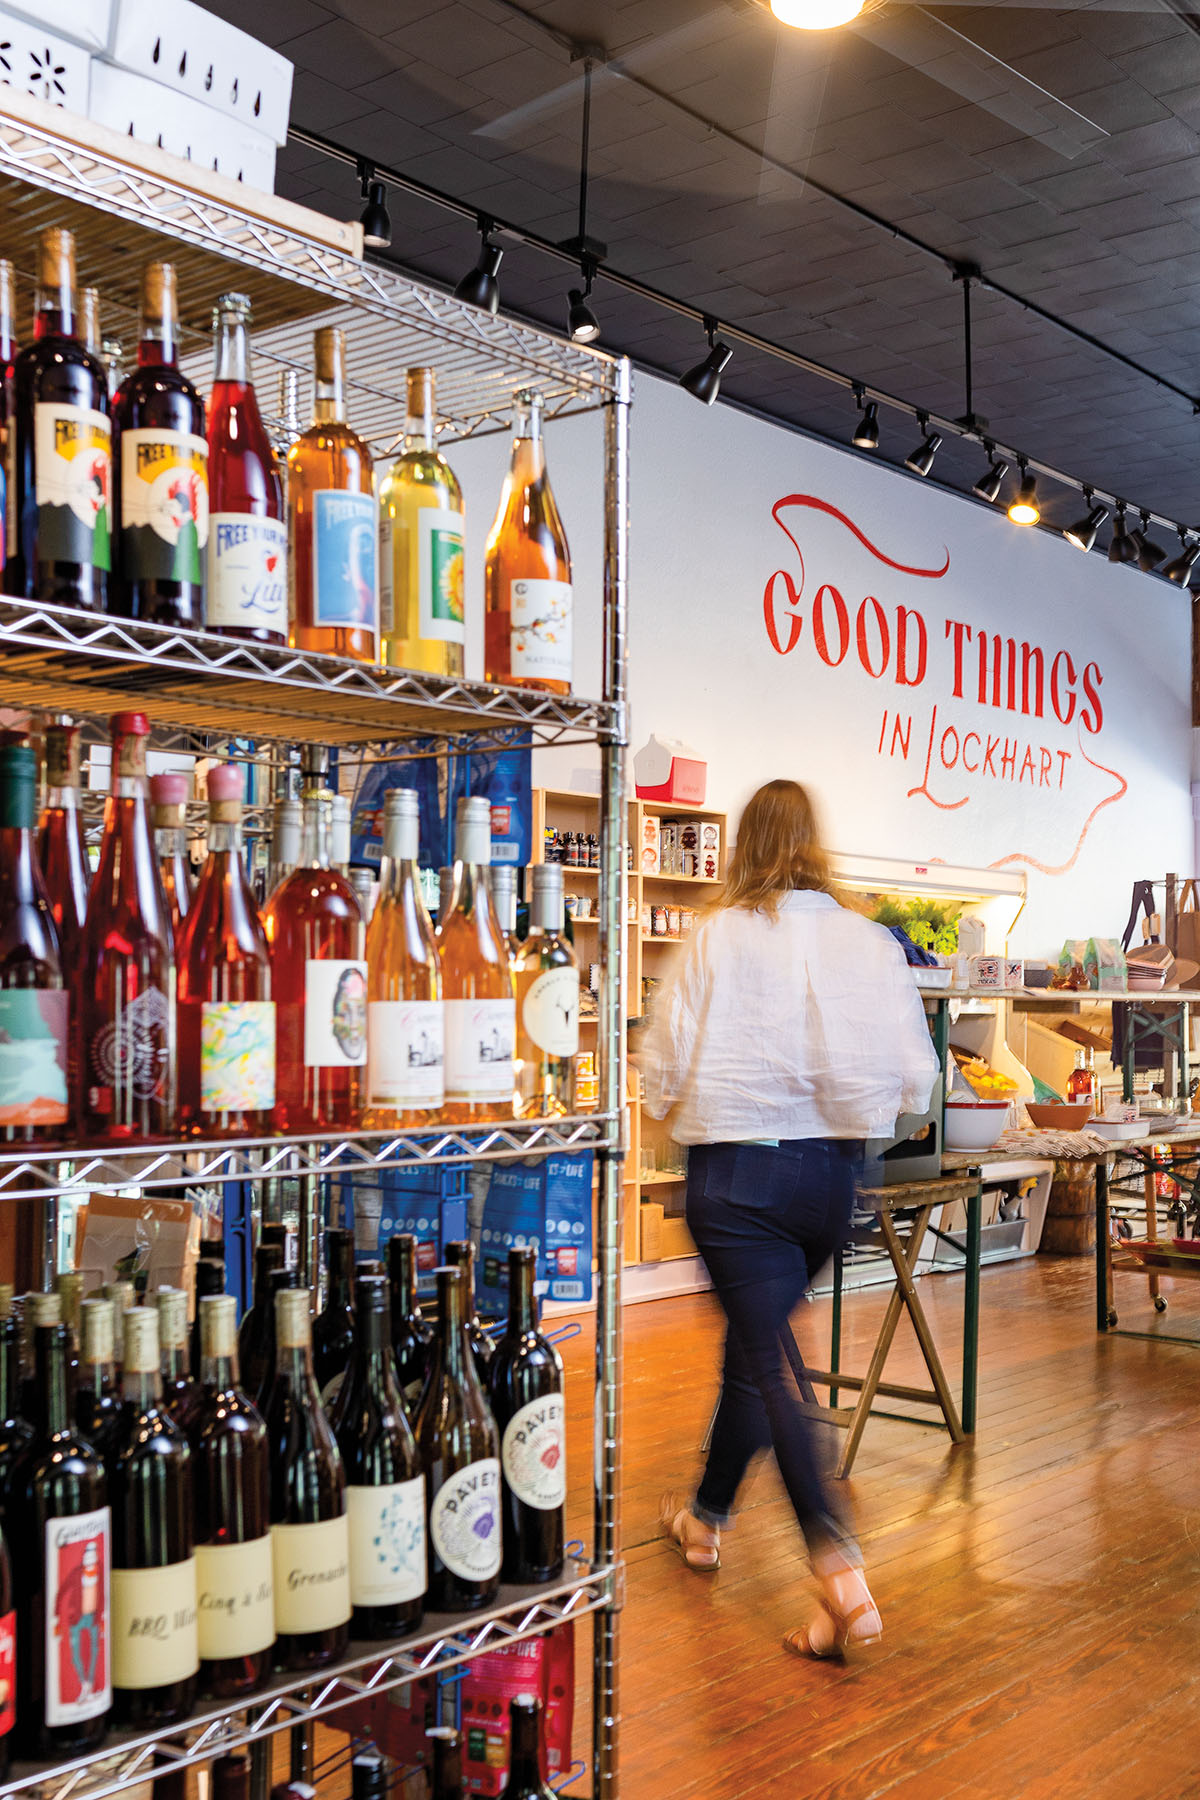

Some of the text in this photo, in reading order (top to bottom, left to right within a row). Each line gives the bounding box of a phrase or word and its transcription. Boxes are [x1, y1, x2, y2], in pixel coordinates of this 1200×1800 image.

[137, 443, 165, 474] FREE
[217, 525, 248, 556] FREE
[763, 569, 1104, 735] GOOD THINGS
[878, 704, 1072, 811] IN LOCKHART
[524, 1177, 541, 1191] LIFE
[566, 1164, 584, 1179] LIFE
[128, 1613, 168, 1640] BBQ
